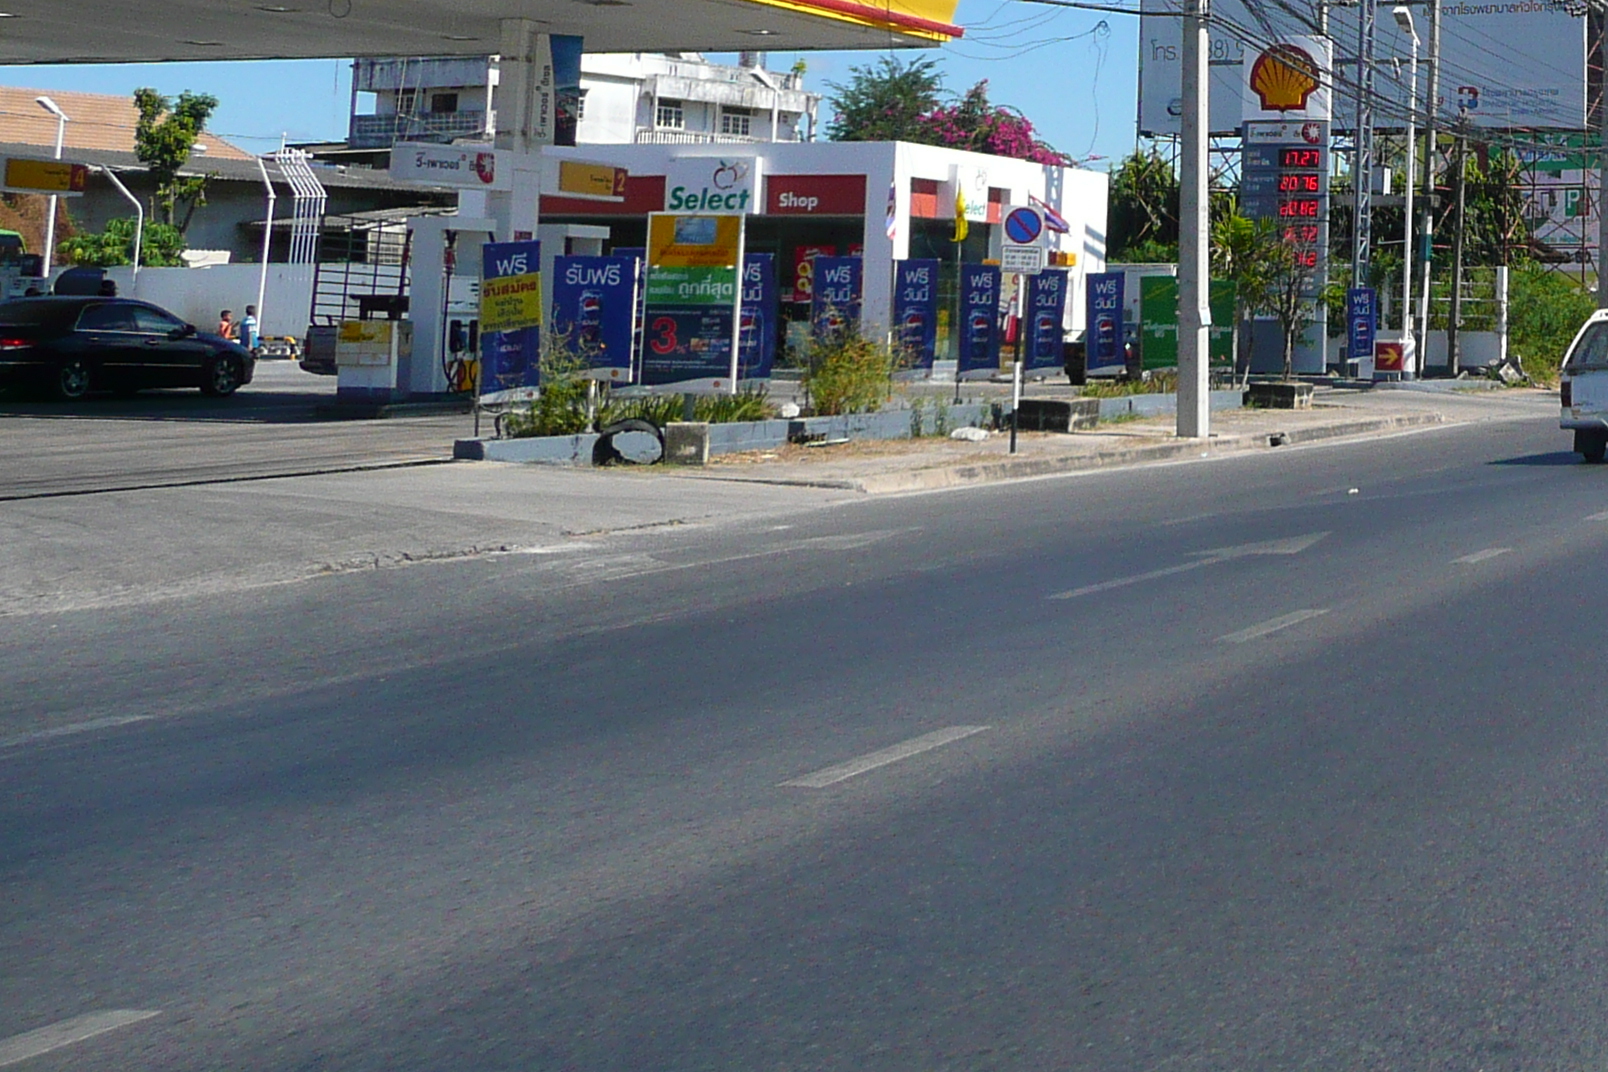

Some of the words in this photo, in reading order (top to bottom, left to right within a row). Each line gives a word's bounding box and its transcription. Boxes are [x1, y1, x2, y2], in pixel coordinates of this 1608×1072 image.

[1151, 39, 1179, 61] โทร.
[75, 169, 84, 187] 4
[617, 173, 625, 192] 2
[668, 186, 750, 210] Select
[779, 192, 818, 210] Shop
[965, 200, 986, 215] elect
[565, 263, 622, 286] รับฟรี
[678, 274, 733, 299] ถูกที่สุด
